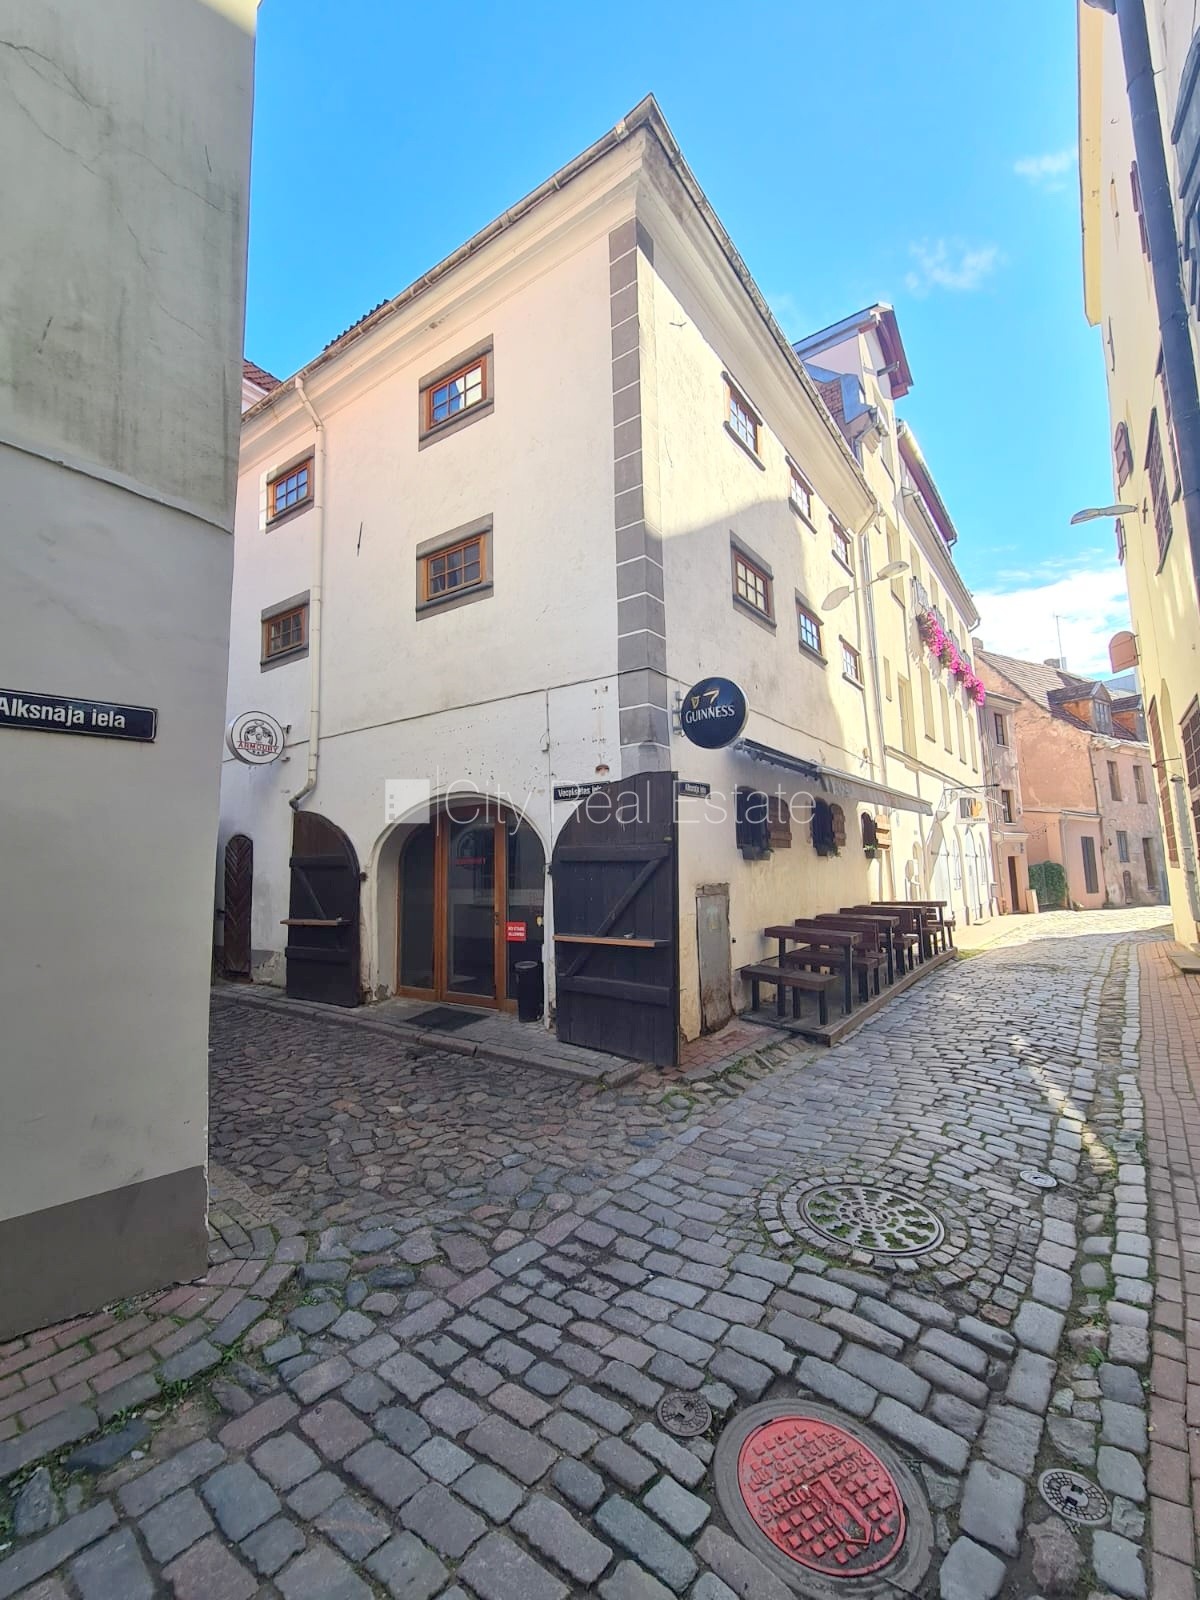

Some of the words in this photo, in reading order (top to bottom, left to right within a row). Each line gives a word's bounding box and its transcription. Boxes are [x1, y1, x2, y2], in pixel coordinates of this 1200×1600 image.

[0, 696, 84, 726] Alksnāja
[91, 708, 125, 728] iela
[685, 704, 735, 724] GUINNESS
[238, 740, 278, 754] ARMOURY
